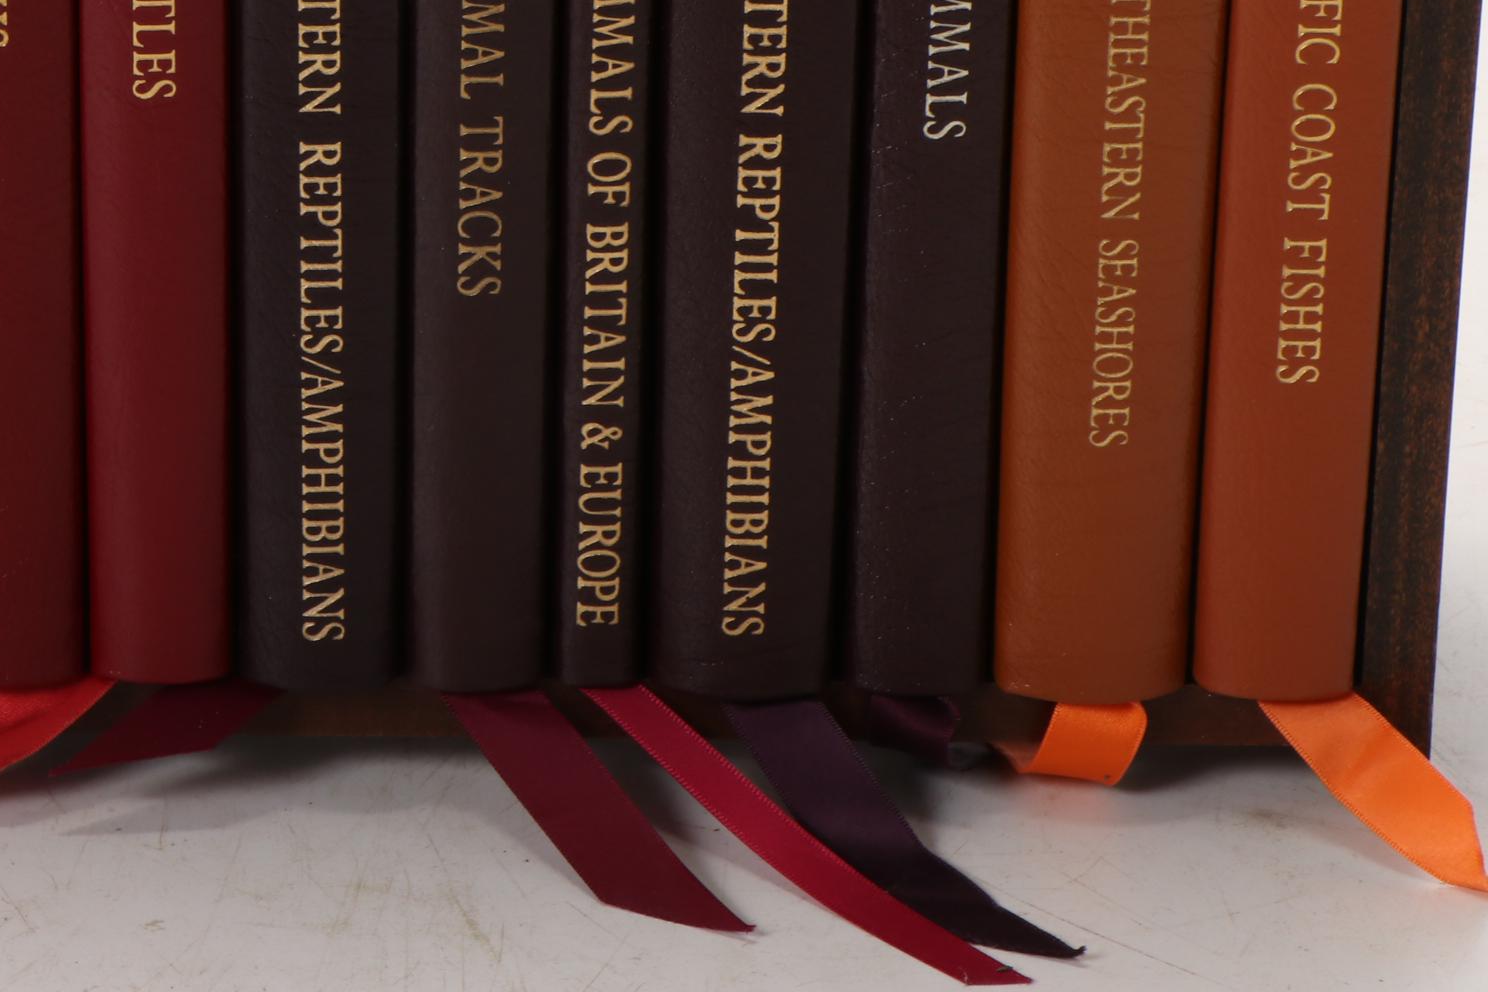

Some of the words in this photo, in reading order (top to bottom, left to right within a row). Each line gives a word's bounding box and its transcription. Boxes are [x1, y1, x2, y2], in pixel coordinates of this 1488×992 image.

[456, 115, 504, 297] TRACKS
[586, 151, 632, 207] OF
[1286, 83, 1338, 221] COAST
[298, 141, 345, 642] REPTILES/AMPHIBIANS
[581, 221, 629, 408] BRITAIN
[721, 133, 783, 636] REPTILES/AMPHIBIANS
[1088, 239, 1140, 448] SEASHORES
[1275, 237, 1328, 384] FISHES
[580, 422, 623, 450] &
[575, 462, 623, 627] EUROPE
